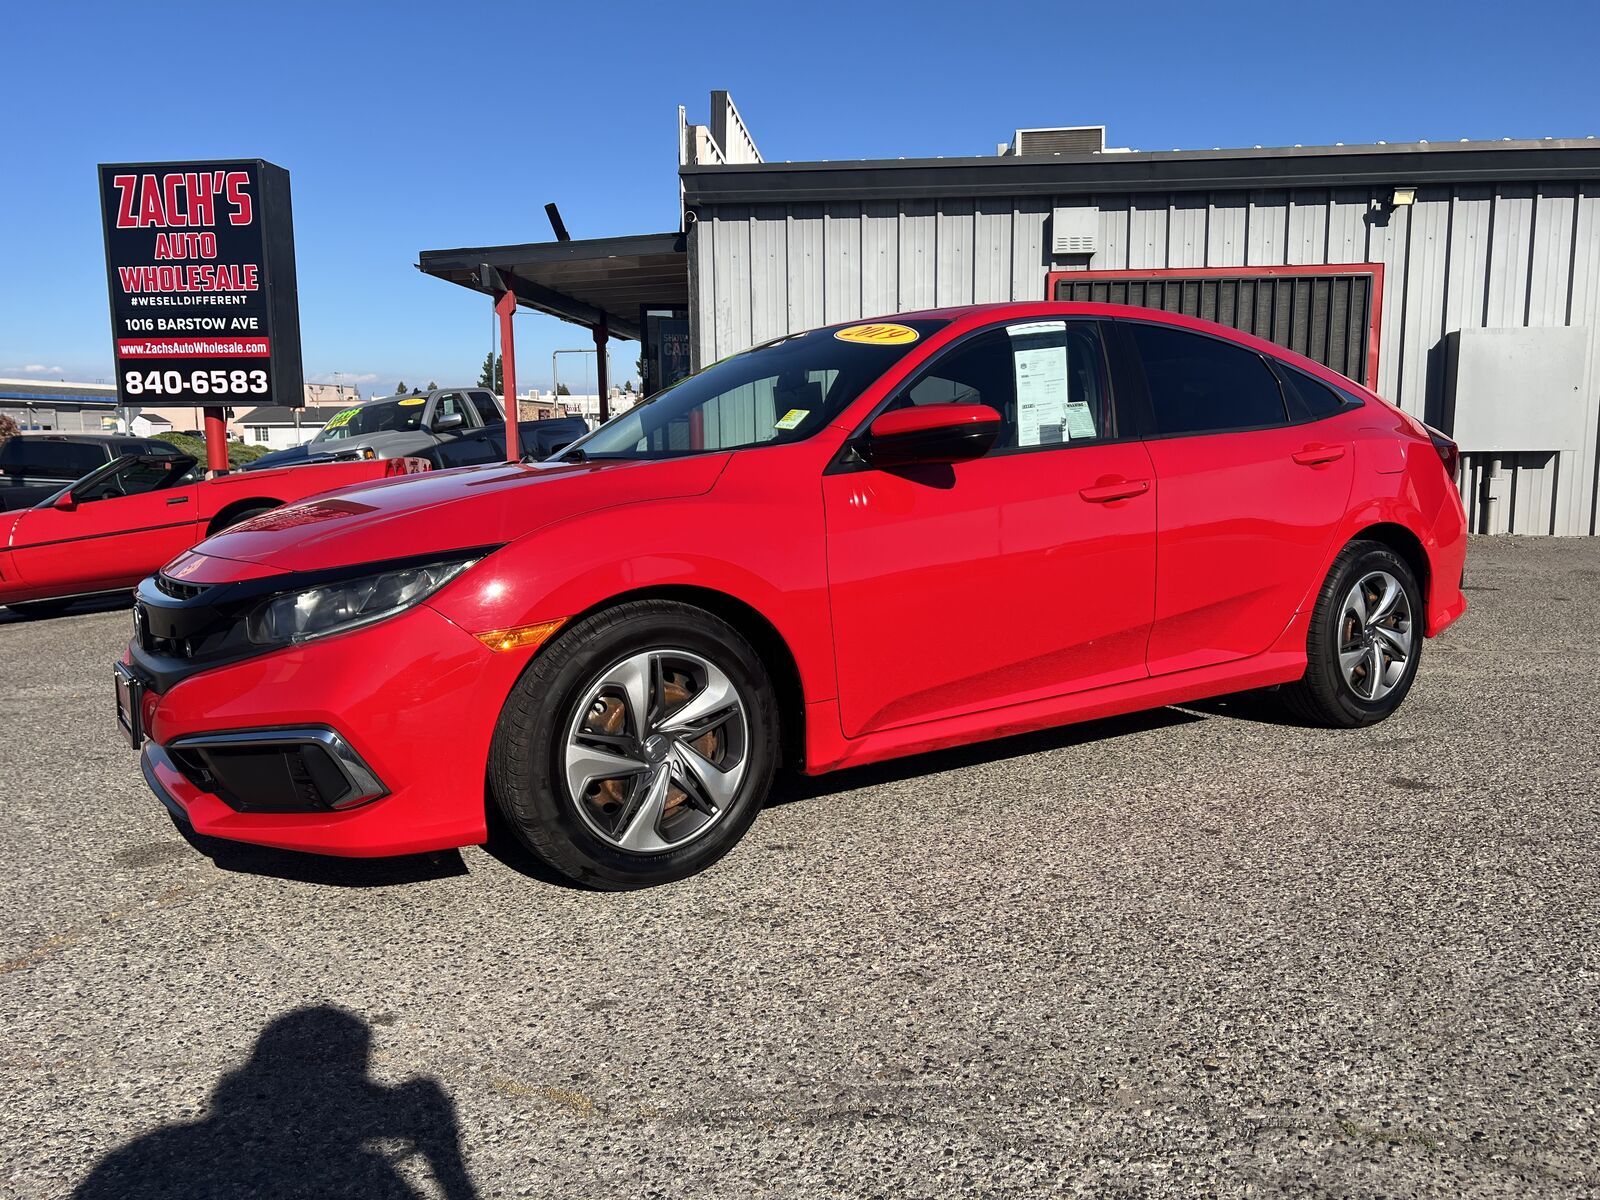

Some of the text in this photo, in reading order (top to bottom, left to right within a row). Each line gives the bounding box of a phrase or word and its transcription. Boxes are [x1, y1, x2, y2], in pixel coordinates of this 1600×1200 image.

[113, 171, 253, 228] ZACH'S
[154, 232, 217, 260] AUTO
[118, 264, 259, 293] WHOLESALE
[131, 296, 247, 306] #WESELLDIFFERENT
[125, 317, 259, 331] 1016 BARSTOW AVE
[843, 326, 910, 339] 2019
[120, 342, 267, 355] www.ZachsAutoWholesale.com
[125, 370, 268, 395] 840-6583
